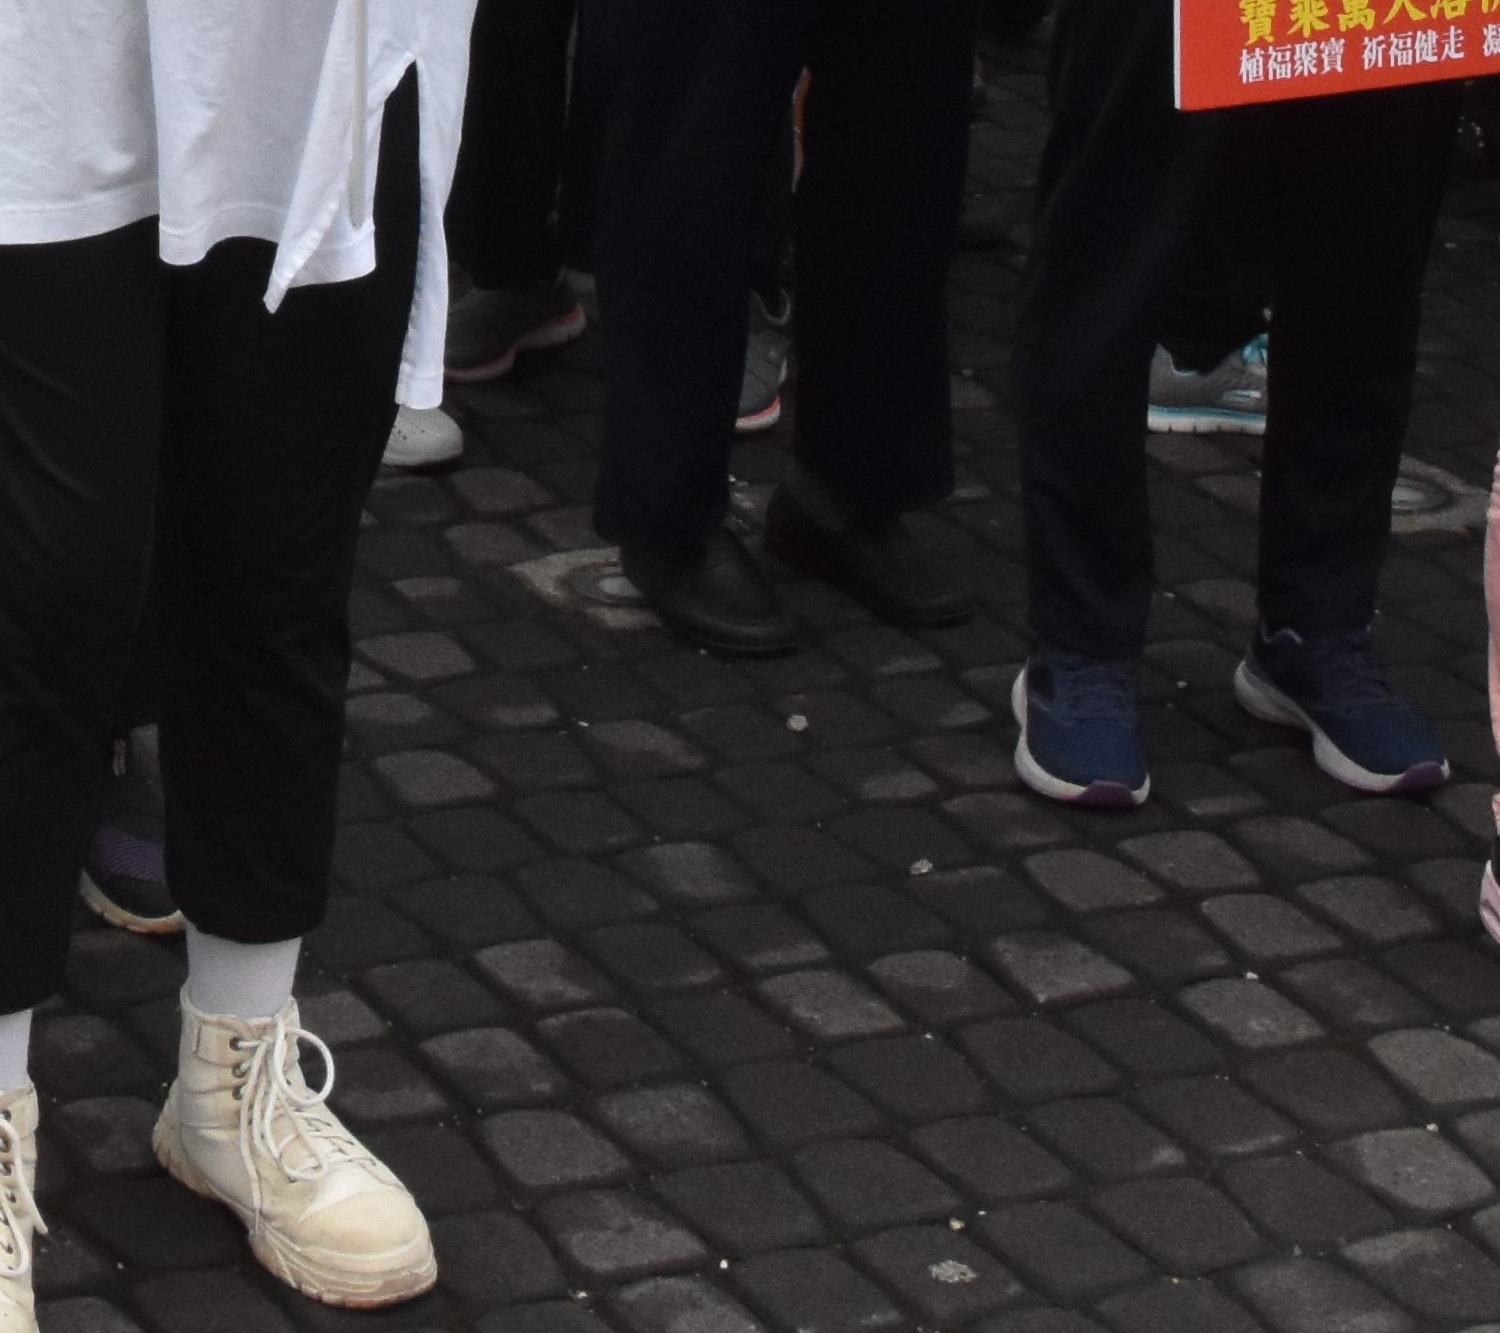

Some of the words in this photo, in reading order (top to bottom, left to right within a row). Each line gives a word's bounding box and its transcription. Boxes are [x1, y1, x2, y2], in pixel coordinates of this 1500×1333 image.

[1238, 35, 1346, 85] 植福聚寶
[1361, 25, 1466, 72] 祈福健走
